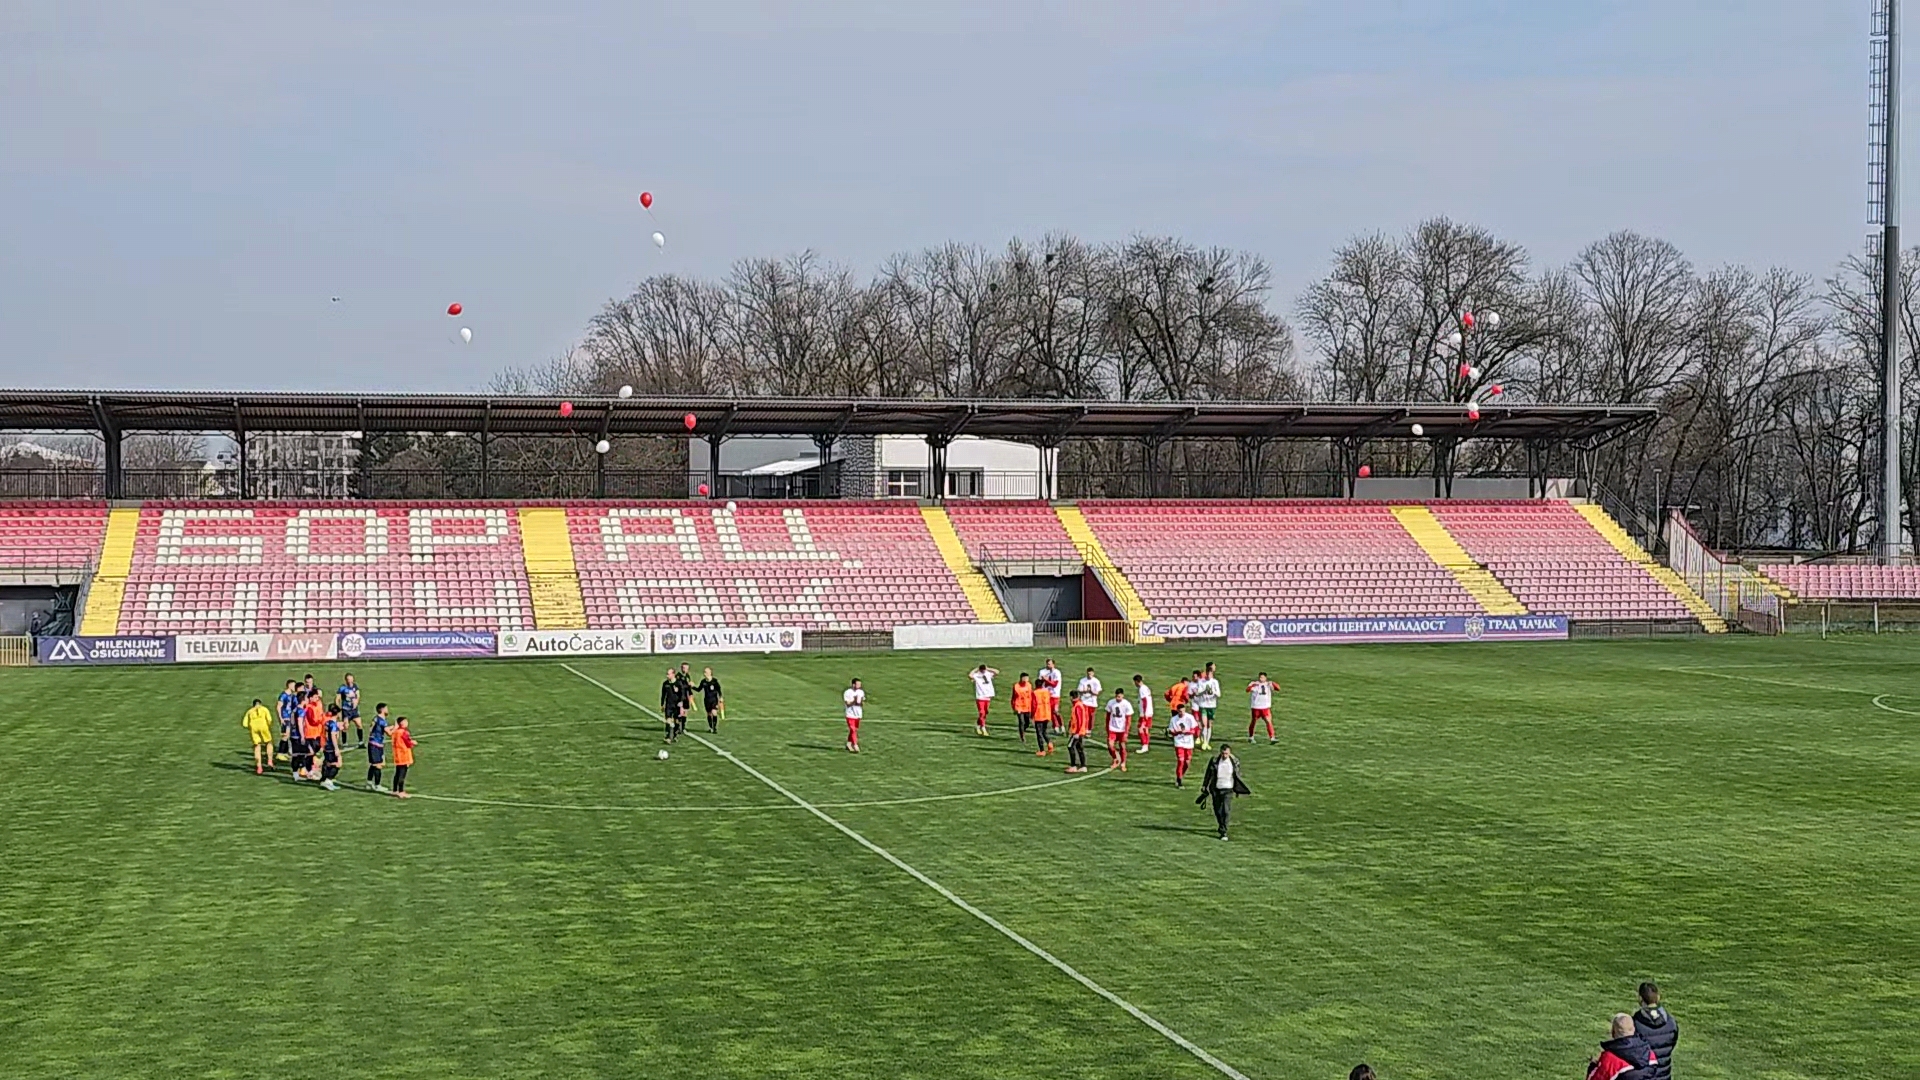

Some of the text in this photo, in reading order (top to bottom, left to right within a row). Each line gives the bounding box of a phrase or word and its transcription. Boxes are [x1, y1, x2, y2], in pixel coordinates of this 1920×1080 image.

[1157, 623, 1224, 635] GIVOVA
[1270, 618, 1558, 633] СПОРТСКИ ЦЕНТАР МЛАДОСТ ГРАД ЧАЧАК
[366, 636, 415, 646] СПОРТСКИ
[416, 636, 451, 646] ЦЕНТАР
[525, 633, 624, 652] AutoČačak
[680, 632, 776, 647] ГРАД ЧАЧАК
[185, 640, 260, 653] TELEVIZIJA
[89, 649, 166, 658] OSIGURANJE
